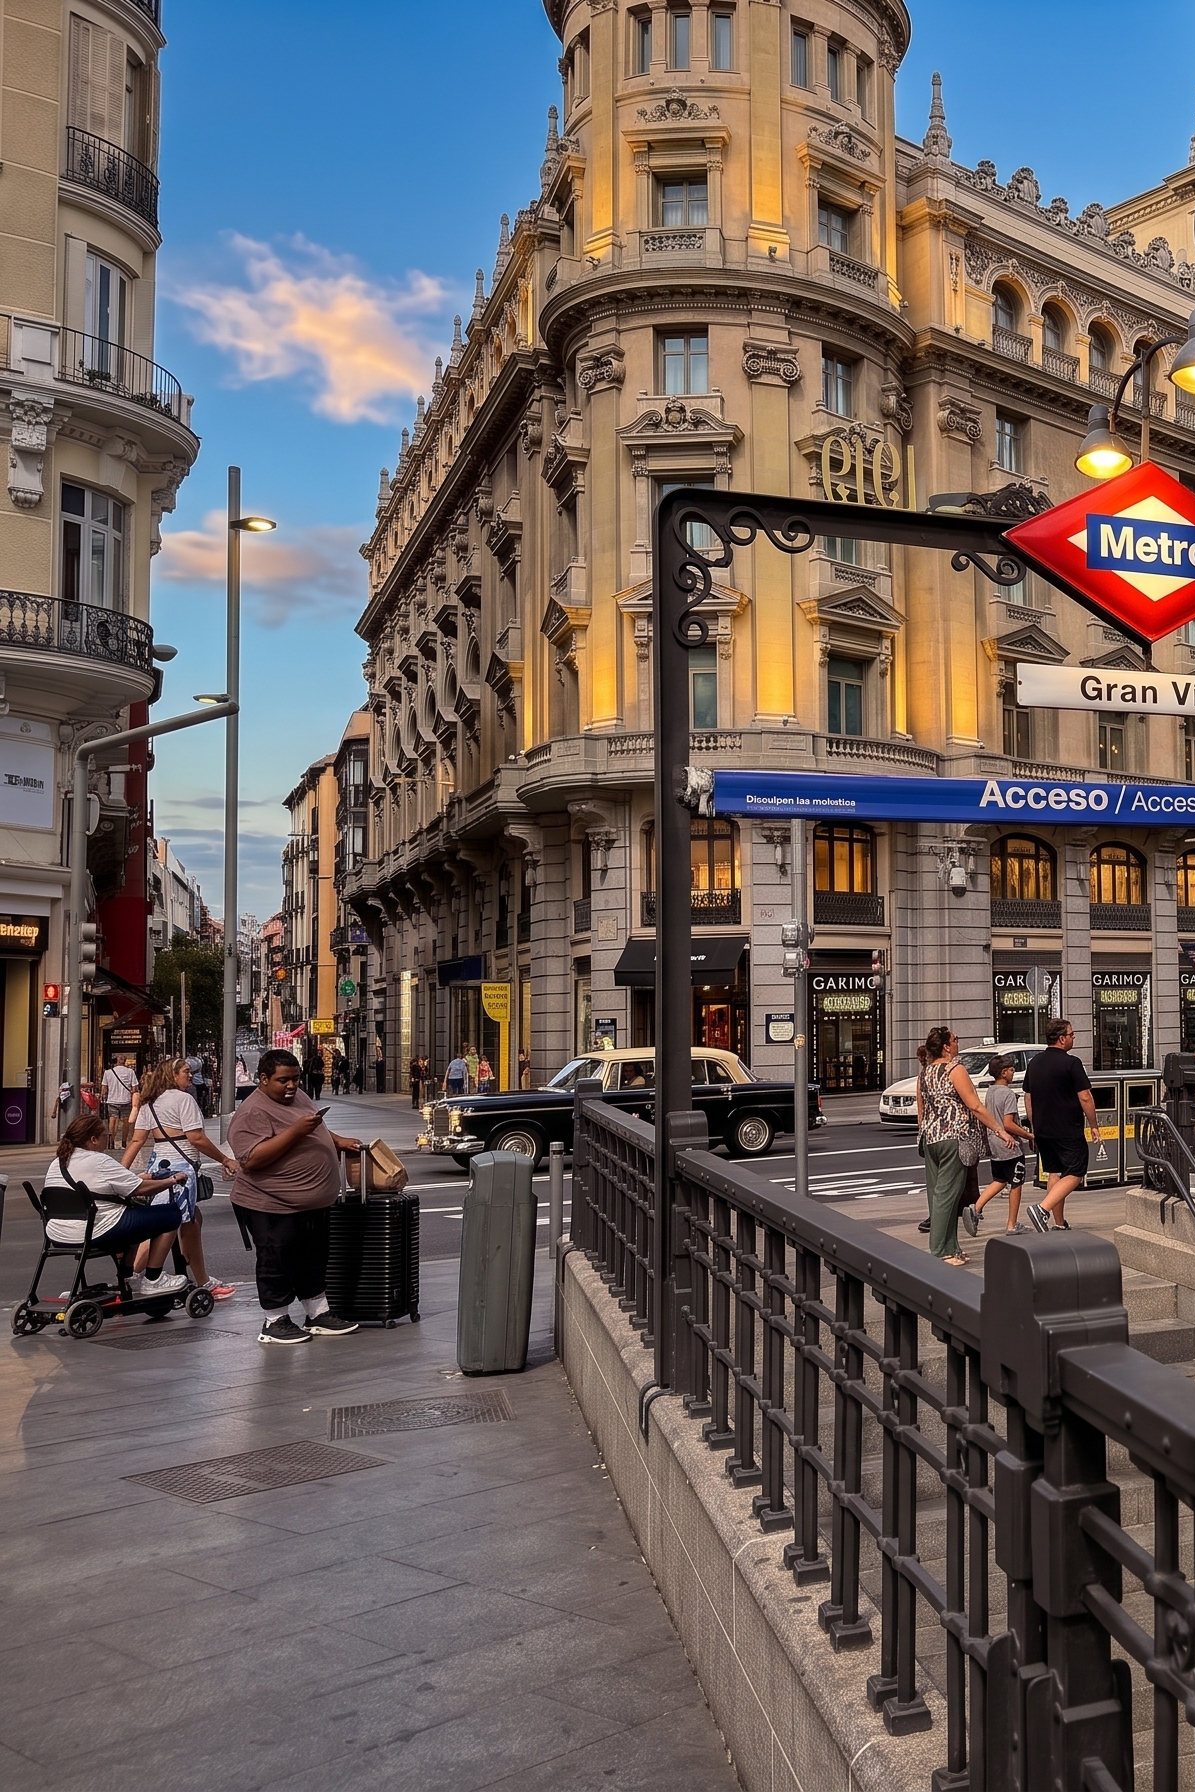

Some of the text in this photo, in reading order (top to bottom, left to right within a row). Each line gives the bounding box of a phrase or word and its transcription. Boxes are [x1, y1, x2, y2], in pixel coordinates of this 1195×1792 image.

[1080, 675, 1158, 705] Gran
[979, 781, 1108, 810] Acceso
[1092, 974, 1143, 986] GARIMO
